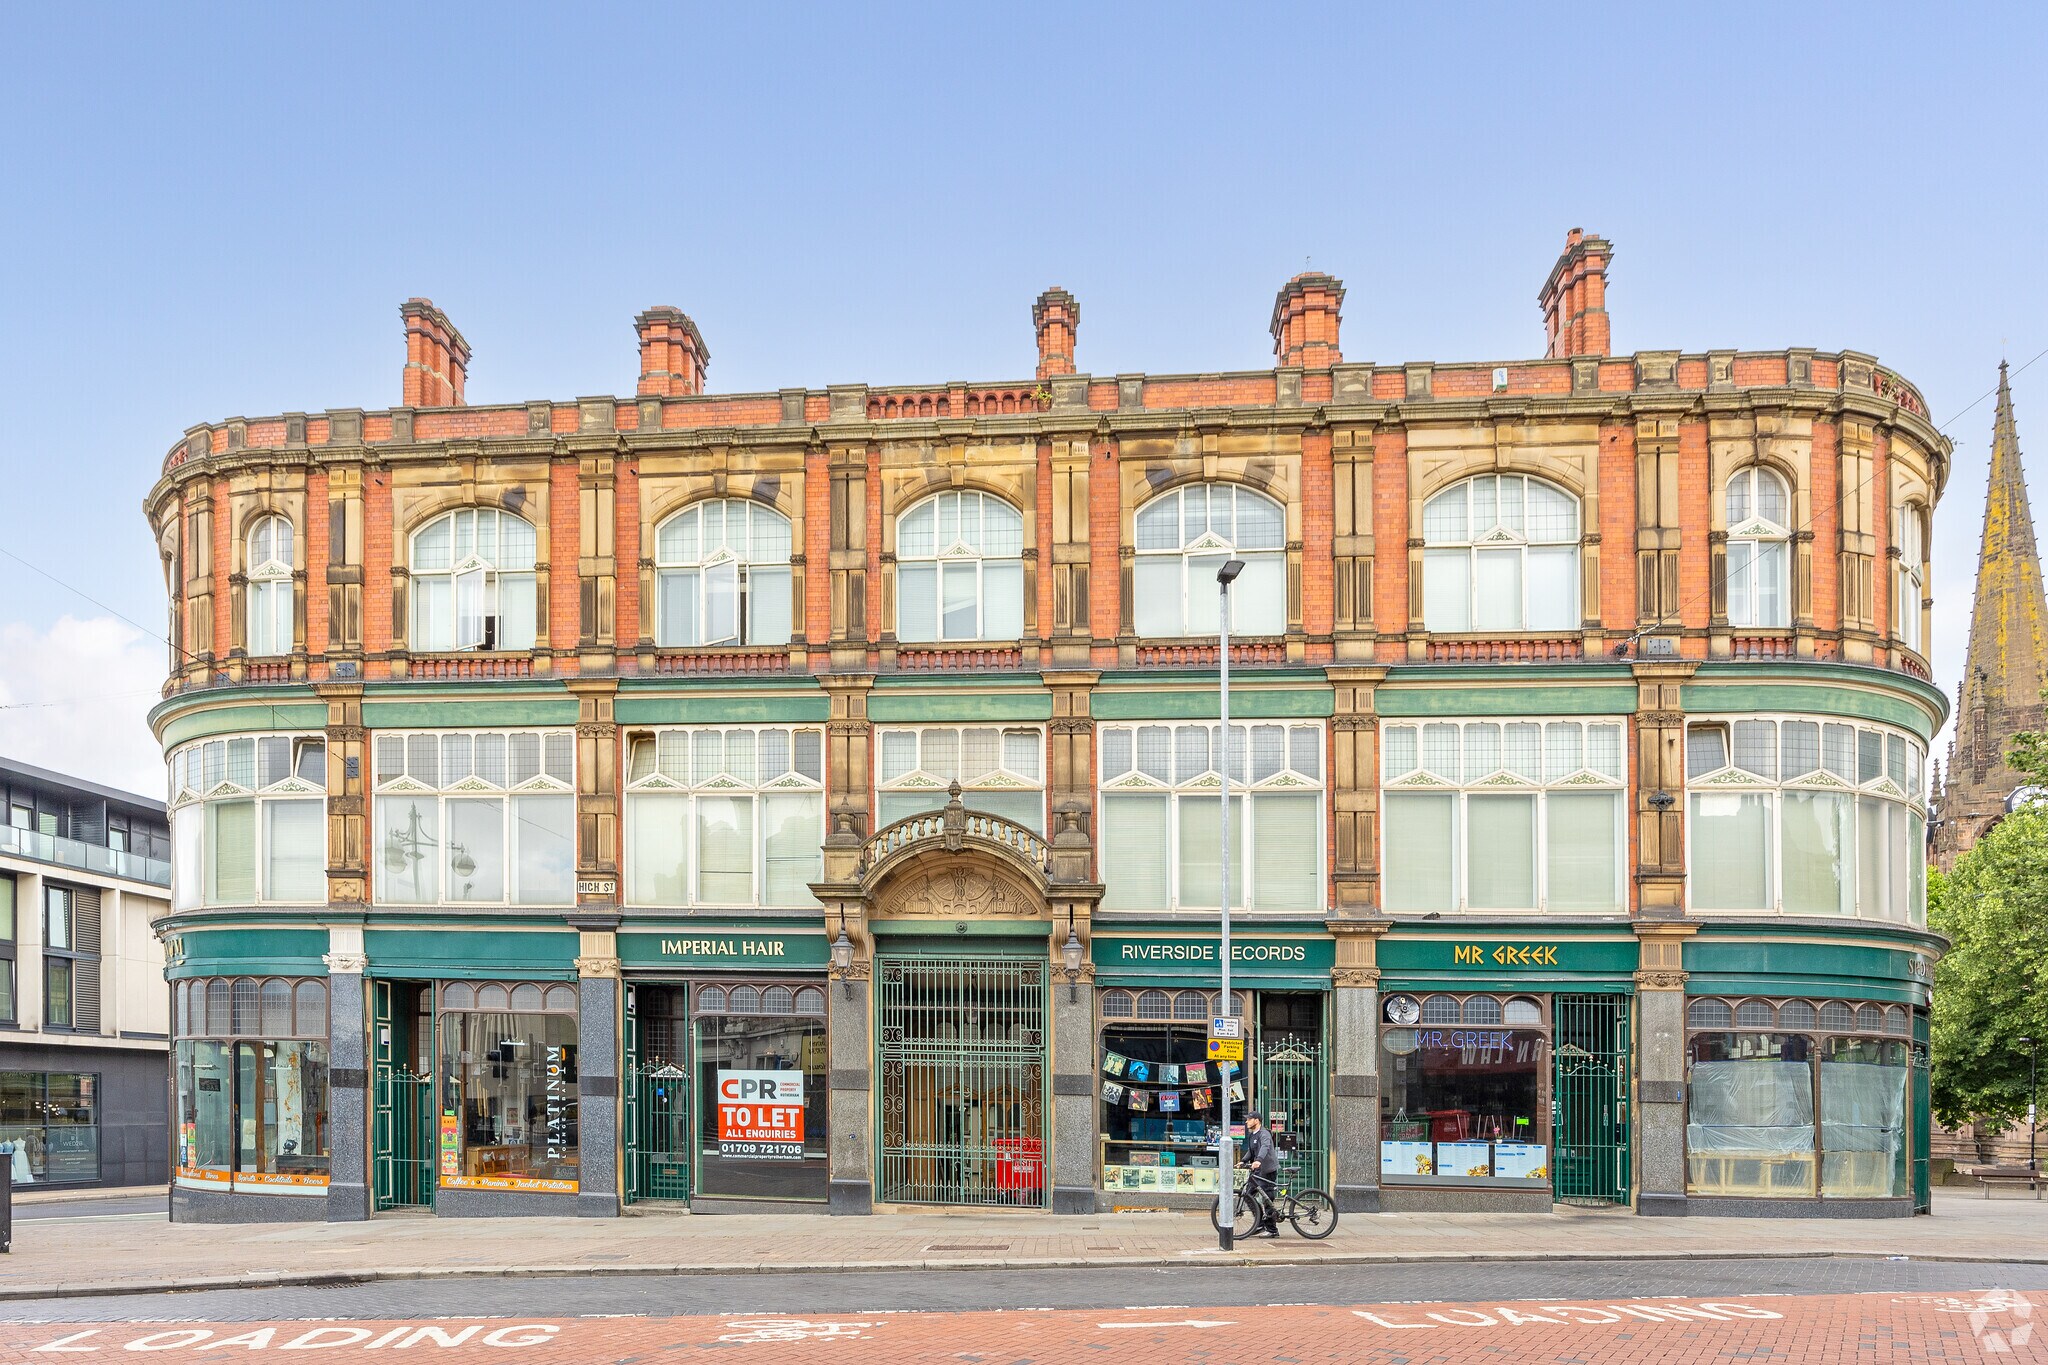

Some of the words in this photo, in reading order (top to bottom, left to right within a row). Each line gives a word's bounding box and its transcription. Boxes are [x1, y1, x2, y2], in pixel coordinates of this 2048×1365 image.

[661, 939, 738, 955] IMPERIAL
[742, 940, 785, 956] HAIR
[1122, 945, 1214, 960] RIVERSIDE
[1219, 945, 1305, 961] ECORDS
[1454, 945, 1484, 965] MR
[1492, 945, 1558, 966] GREEK
[1451, 1030, 1514, 1049] GREEK
[721, 1079, 777, 1099] CPR
[547, 1046, 560, 1159] PLATINUM
[722, 1107, 751, 1127] TO
[758, 1108, 800, 1128] LET
[726, 1129, 743, 1138] ALL
[746, 1129, 796, 1138] ENQUIRIES
[721, 1143, 757, 1153] 01709
[760, 1145, 801, 1154] 721706
[237, 1174, 256, 1183] Spirits
[264, 1175, 293, 1184] Cocktails
[303, 1177, 323, 1185] Beers
[481, 1178, 509, 1187] Paninis
[516, 1179, 541, 1189] Jacket
[541, 1181, 573, 1190] Potatoes
[1351, 1302, 1784, 1329] LOADING
[29, 1324, 560, 1352] LOADING
